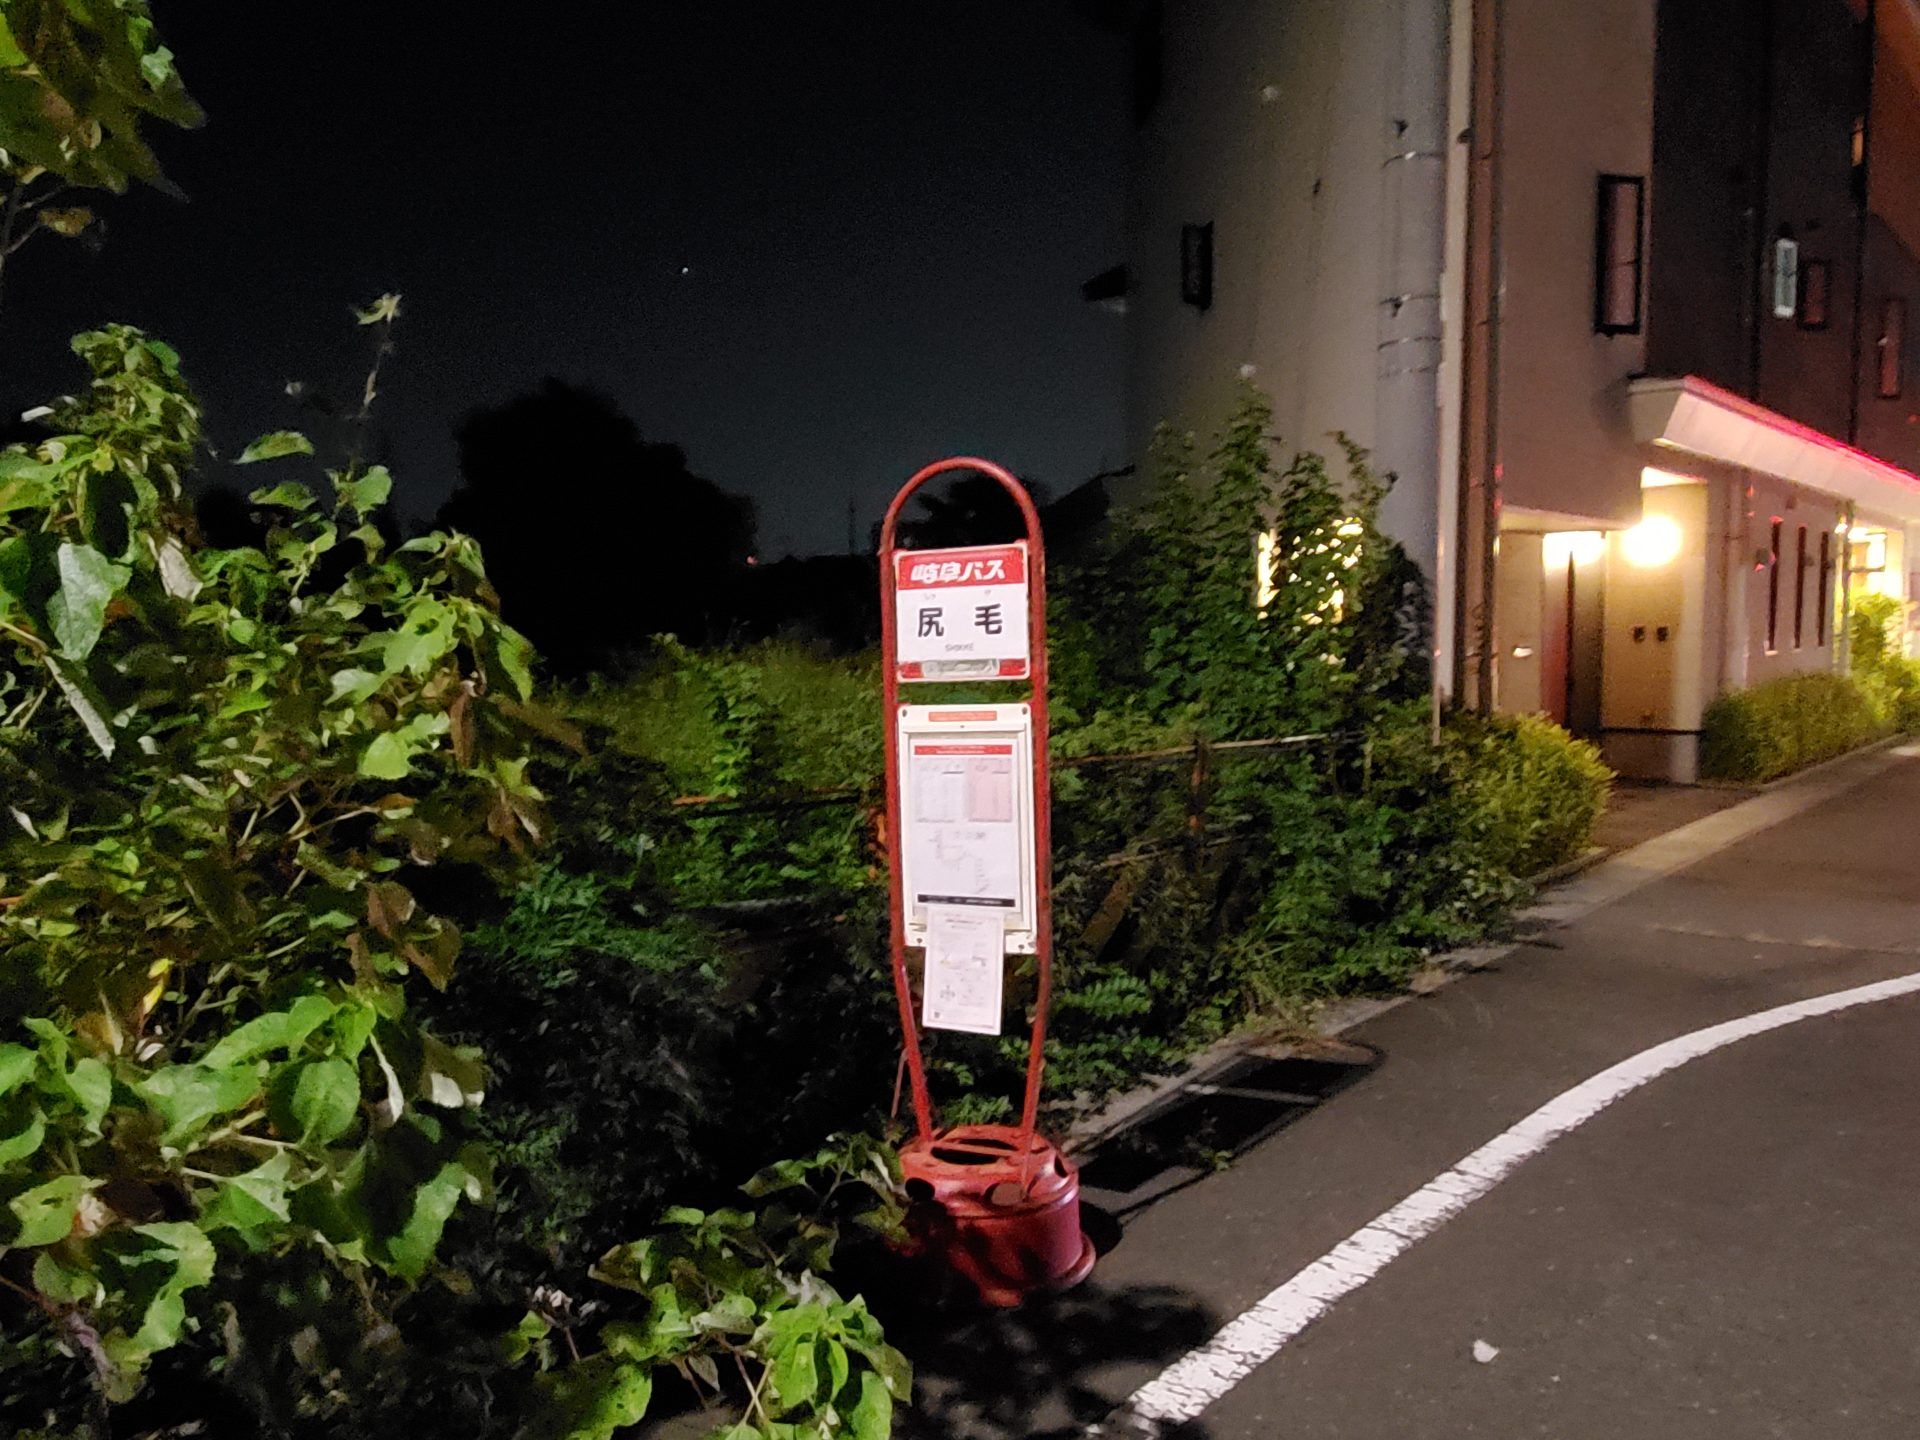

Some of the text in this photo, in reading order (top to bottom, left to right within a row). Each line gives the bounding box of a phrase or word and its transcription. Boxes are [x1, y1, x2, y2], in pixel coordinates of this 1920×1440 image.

[910, 560, 1006, 584] 岐阜バス
[918, 603, 1002, 637] 尻毛
